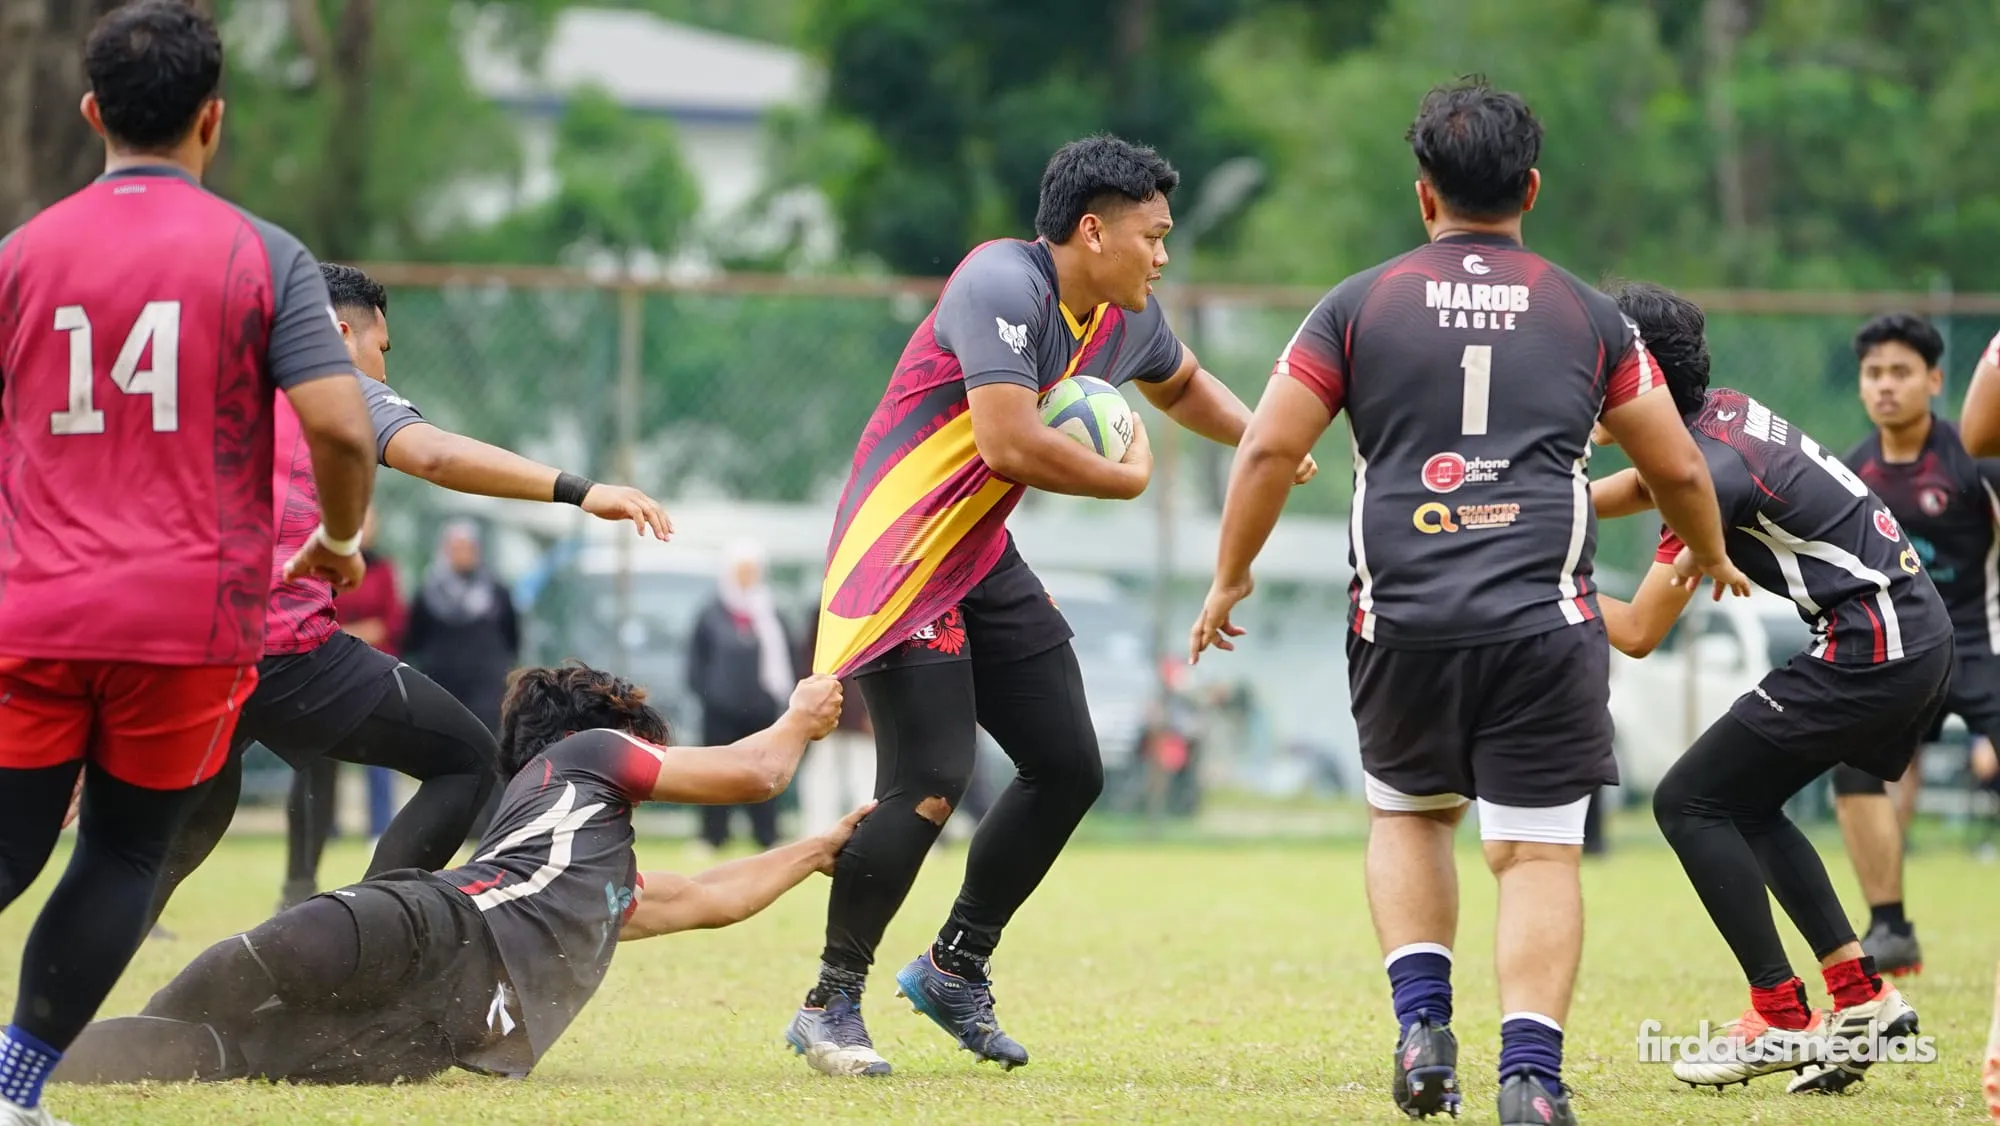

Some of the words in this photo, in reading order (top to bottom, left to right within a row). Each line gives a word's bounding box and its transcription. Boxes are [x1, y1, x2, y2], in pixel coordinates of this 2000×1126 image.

[1426, 281, 1530, 312] MAROB
[1438, 310, 1516, 330] EAGLE
[51, 300, 181, 435] 14
[1460, 345, 1492, 435] 1
[1464, 469, 1499, 482] clinic
[1465, 456, 1510, 472] phone
[1801, 434, 1869, 497] 6
